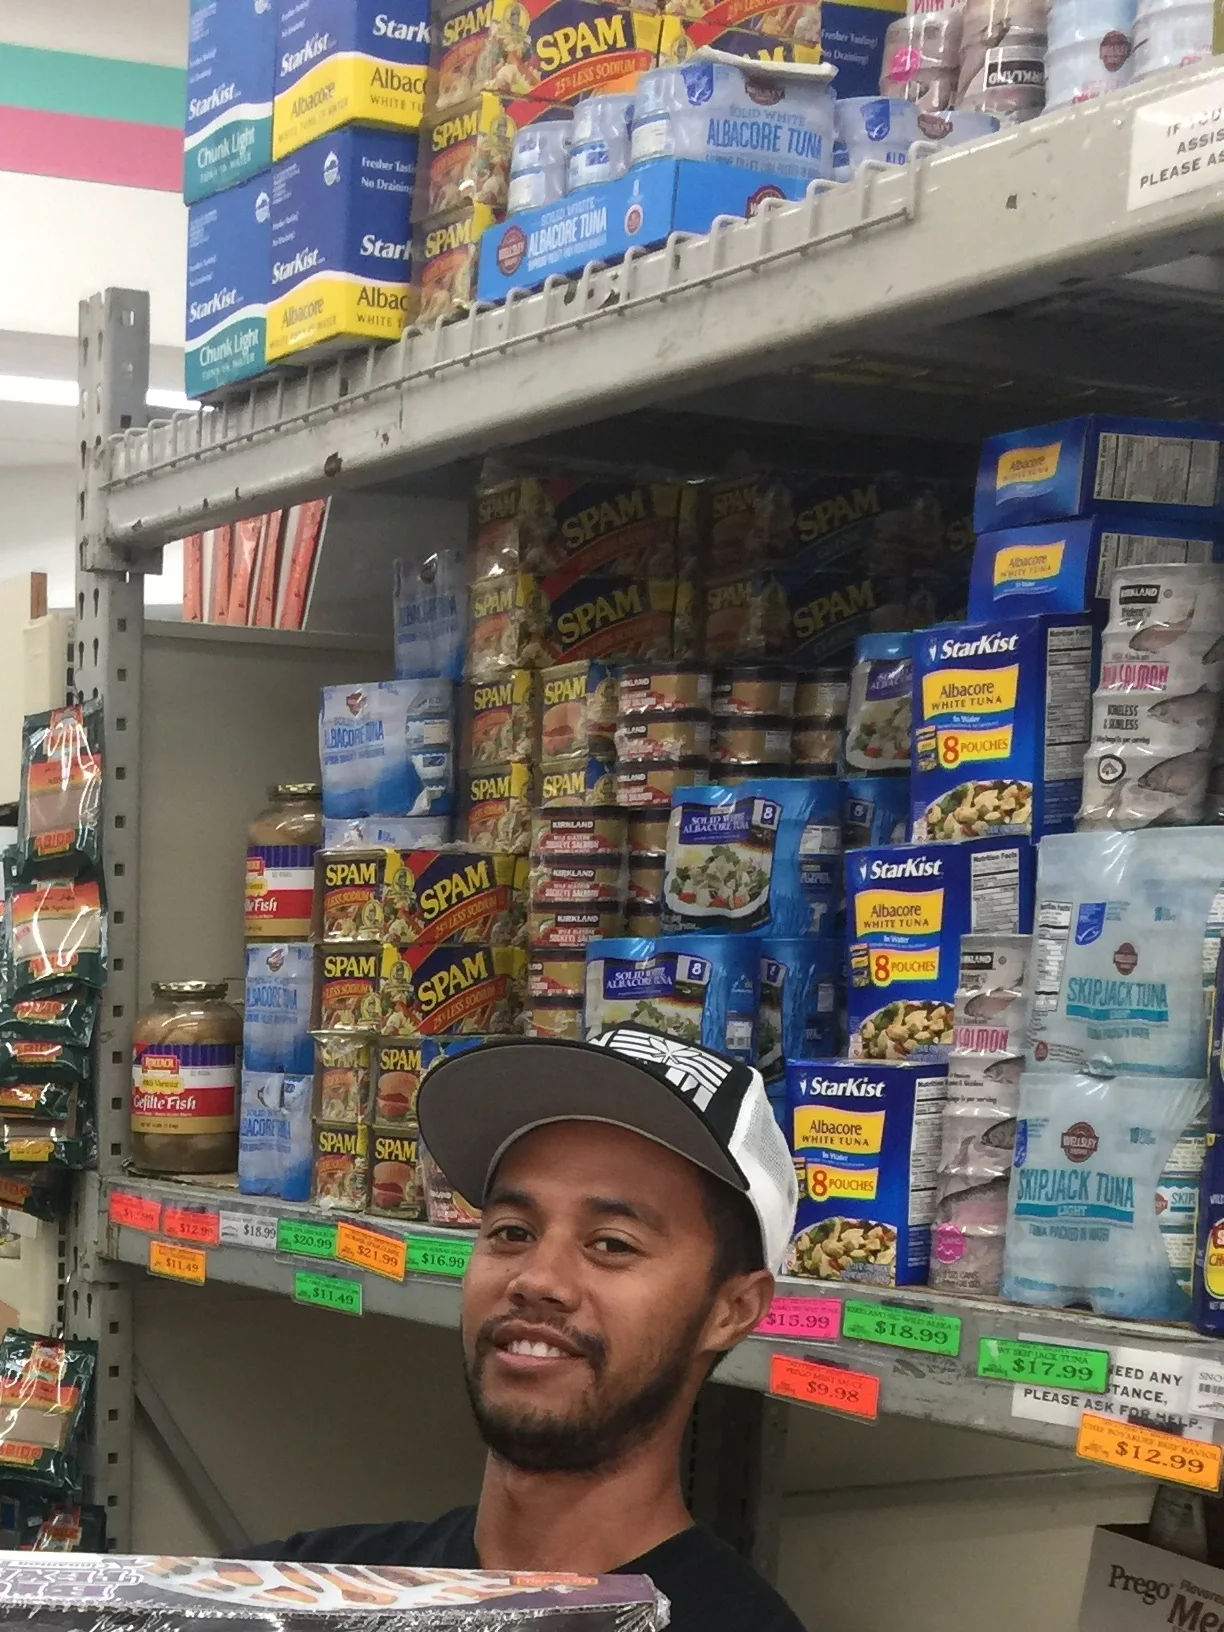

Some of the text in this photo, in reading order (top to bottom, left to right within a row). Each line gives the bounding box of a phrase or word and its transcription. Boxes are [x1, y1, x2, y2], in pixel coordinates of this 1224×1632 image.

[280, 32, 330, 77] StarKist
[536, 14, 627, 71] SPAM
[188, 83, 237, 120] StarKist
[197, 136, 229, 169] Chunk
[230, 126, 256, 155] Light
[707, 118, 823, 161] ALBACORE TUNA
[1140, 157, 1202, 190] PLEASE
[527, 219, 578, 259] ALBACORE
[579, 206, 608, 239] TUNA
[272, 247, 320, 284] StarKist
[188, 287, 238, 323] StarKist
[282, 297, 325, 329] Albacore
[199, 340, 232, 367] Chunk
[232, 327, 259, 357] Light
[556, 585, 644, 644] SPAM
[940, 632, 1020, 660] StarKist
[544, 675, 588, 706] SPAM
[939, 681, 995, 699] Albacore
[931, 695, 1003, 711] WHITE TUNA
[942, 736, 1009, 764] 8 POUCHES
[552, 820, 594, 830] KIRKLAND
[682, 820, 733, 835] ALBACORE
[870, 856, 943, 880] StarKist
[973, 851, 1019, 863] Nutrition Facts
[326, 863, 377, 887] SPAM
[553, 869, 594, 879] KIRKLAND
[421, 860, 492, 920] SPAM
[254, 897, 277, 913] Fish
[871, 901, 923, 919] Albacore
[557, 915, 599, 924] KIRKLAND
[863, 918, 930, 930] WHITE TUNA
[324, 956, 376, 979] SPAM
[875, 954, 936, 982] 8 POUCHES
[418, 952, 489, 1012] SPAM
[1066, 977, 1132, 1011] SKIPJACK
[445, 999, 466, 1021] LESS
[380, 1049, 421, 1072] SPAM
[810, 1076, 886, 1099] StarKist
[133, 1094, 197, 1111] Gefilte Fish
[810, 1118, 863, 1136] Albacore
[375, 1138, 418, 1162] SPAM
[802, 1135, 870, 1147] WHITE TUNA
[812, 1169, 874, 1197] 8 POUCHES
[1018, 1168, 1136, 1208] SKIPJACK TUNA
[243, 1223, 278, 1240] $18.99
[293, 1233, 334, 1251] $20.99
[164, 1255, 200, 1274] $11.49
[357, 1244, 399, 1268] $21.99
[421, 1251, 466, 1270] $16.99
[312, 1286, 355, 1306] $11.49
[766, 1312, 830, 1329] $15.99
[874, 1319, 949, 1345] $18.99
[1012, 1357, 1094, 1382] $17.99
[1149, 1368, 1184, 1387] ANY
[806, 1380, 860, 1403] $9.98
[1024, 1388, 1203, 1431] PLEASE ASK FOR HELP.
[1115, 1440, 1205, 1475] $12.99
[1109, 1563, 1171, 1606] Prego
